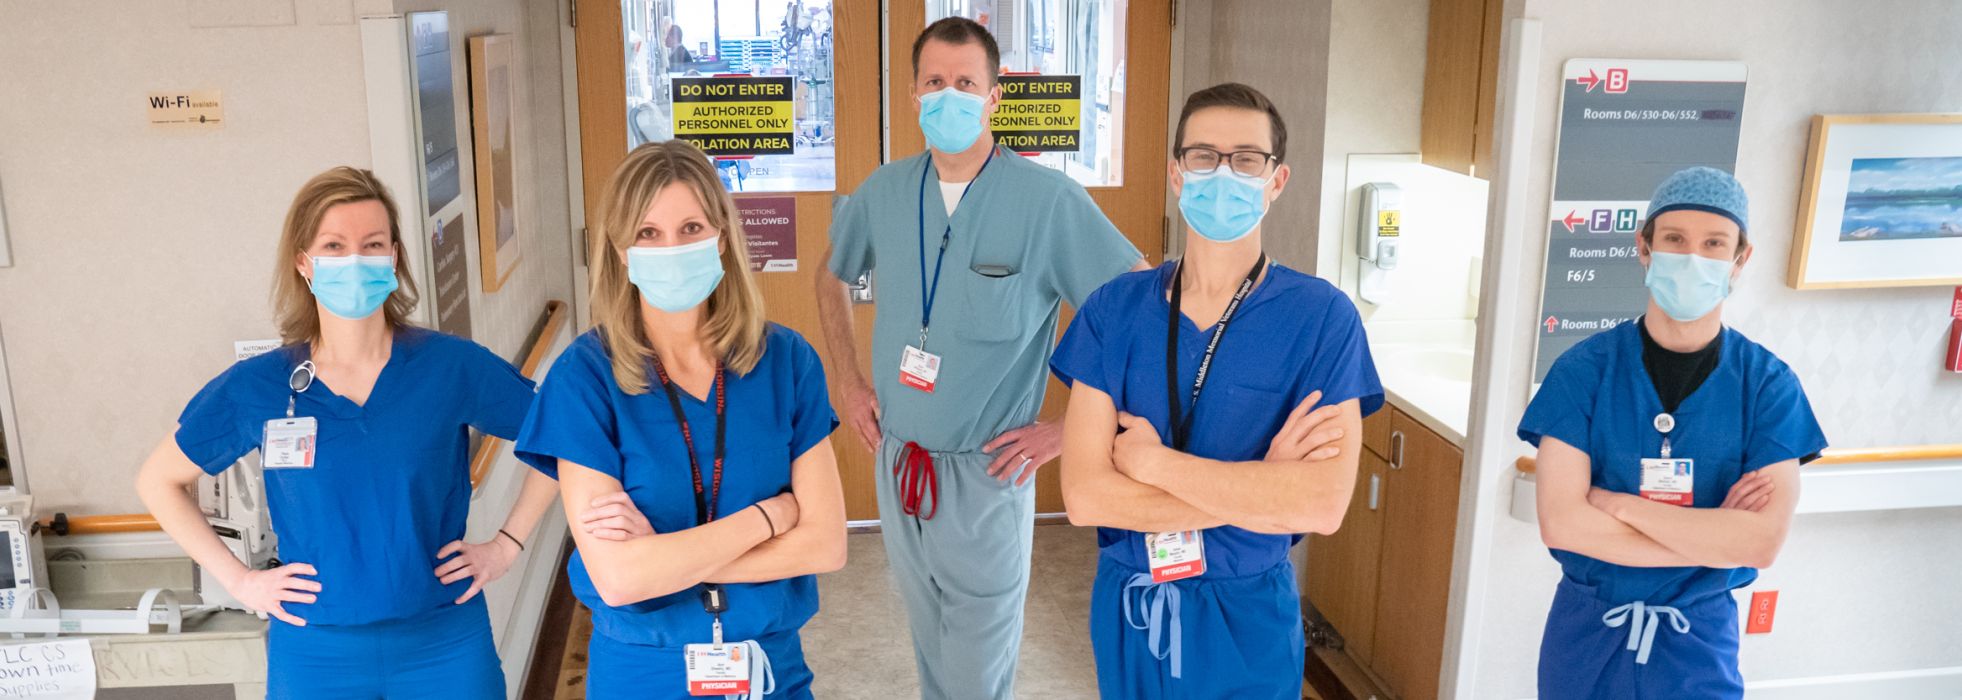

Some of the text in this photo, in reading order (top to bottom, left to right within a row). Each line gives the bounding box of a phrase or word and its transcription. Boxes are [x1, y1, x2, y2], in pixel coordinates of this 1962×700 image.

[1609, 71, 1624, 90] B
[680, 84, 784, 96] DO NOT ENTER
[998, 82, 1072, 93] NOT ENTER
[149, 96, 190, 109] Wi-Fi
[693, 106, 774, 117] AUTHORIZED
[1584, 108, 1622, 120] Rooms
[679, 118, 789, 130] PERSONNEL ONLY
[1044, 116, 1075, 126] ONLY
[687, 138, 790, 150] OLATION AREA
[998, 135, 1076, 146] ATION AREA
[745, 167, 770, 176] PEN
[745, 217, 789, 226] ALLOWED
[1594, 211, 1635, 229] F H
[1569, 246, 1640, 258] Rooms D6/5
[1567, 269, 1596, 282] F6/5
[1561, 319, 1598, 329] Rooms
[0, 646, 32, 664] LC
